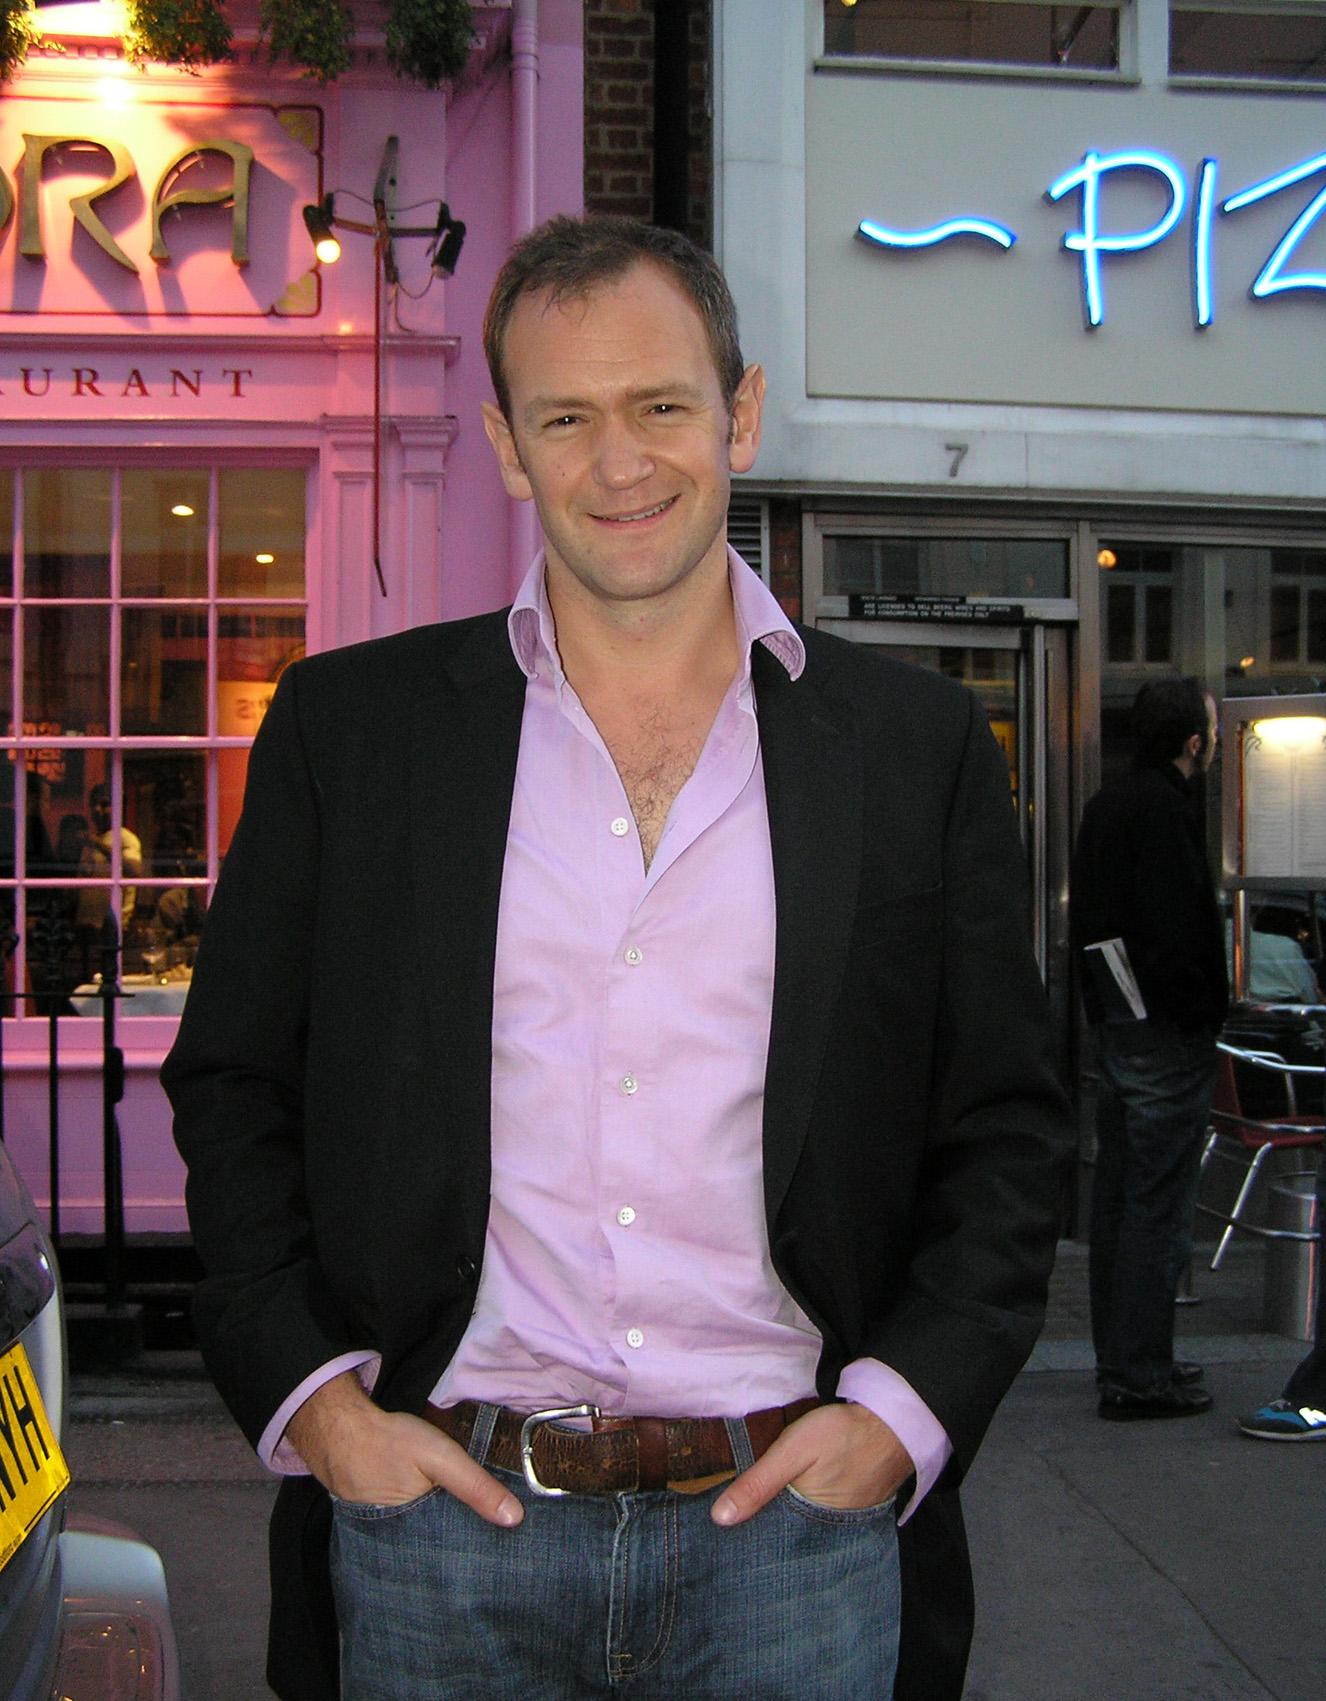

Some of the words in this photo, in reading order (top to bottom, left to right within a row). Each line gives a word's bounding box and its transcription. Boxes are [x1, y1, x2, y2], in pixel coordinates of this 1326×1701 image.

[0, 133, 254, 277] RA
[0, 367, 254, 399] URANT
[945, 443, 969, 478] 7
